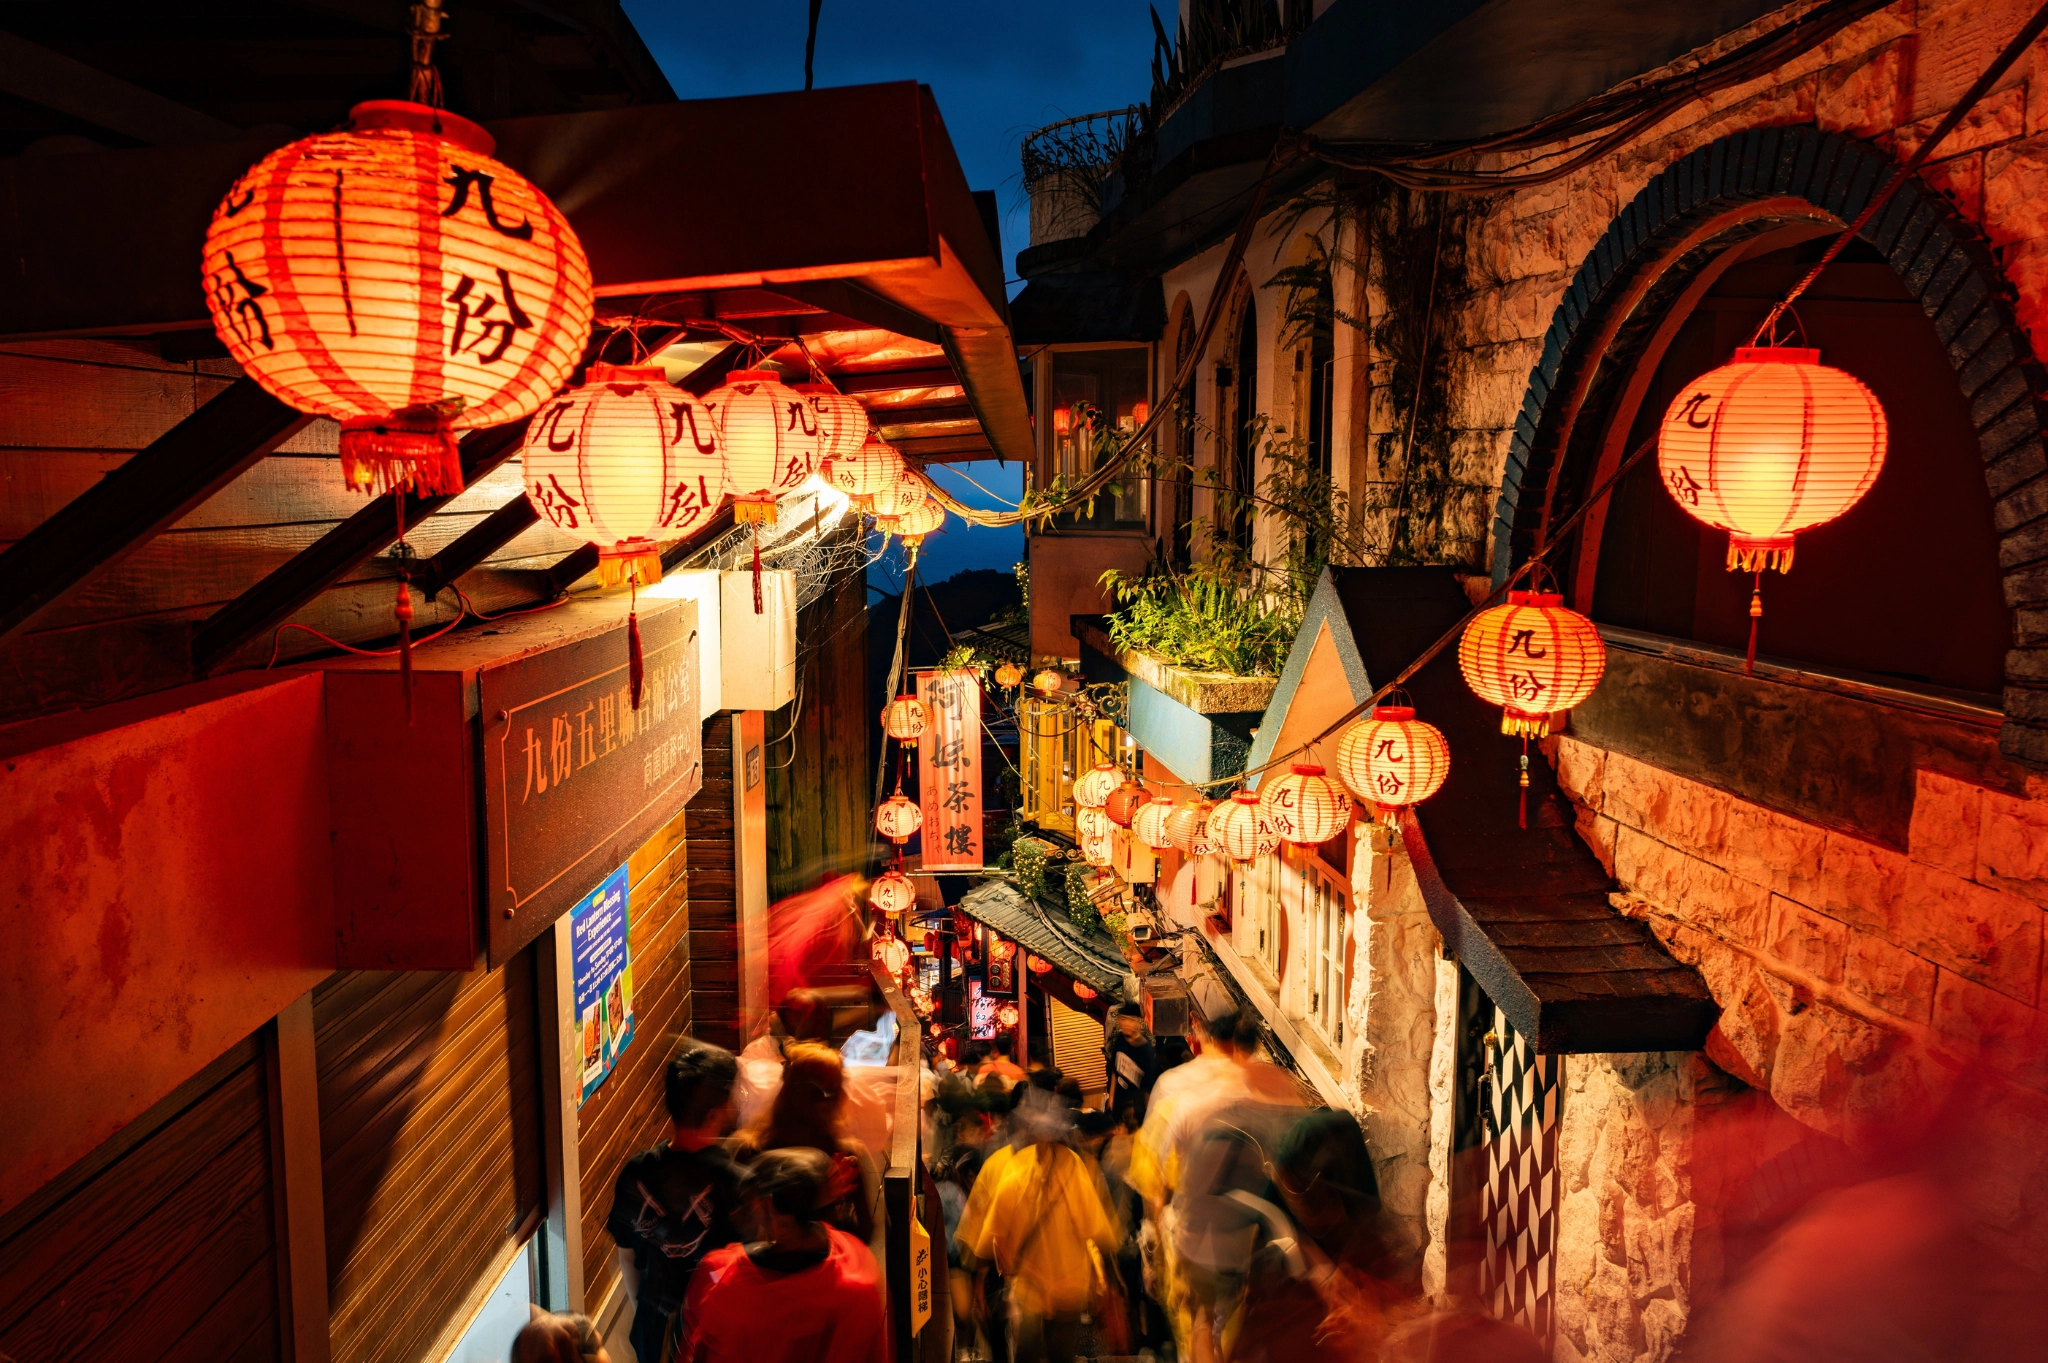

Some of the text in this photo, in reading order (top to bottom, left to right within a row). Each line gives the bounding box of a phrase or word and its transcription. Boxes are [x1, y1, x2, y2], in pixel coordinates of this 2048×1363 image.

[441, 165, 534, 365] 九份
[532, 400, 581, 529] 九份
[661, 401, 717, 529] 九份
[779, 401, 817, 488] 九份
[1670, 392, 1711, 507] 九份
[900, 472, 917, 507] 九份
[1507, 629, 1547, 702] 九份
[521, 655, 690, 806] 九份五里聯合辦公室
[910, 707, 924, 734] 九份
[925, 679, 978, 857] 阿妹茶樓
[1374, 739, 1405, 795] 九份
[883, 810, 895, 835] 九份
[926, 785, 943, 853] あめおちゃ
[1194, 821, 1209, 854] 九份
[1258, 820, 1274, 855] 九份
[1273, 788, 1296, 835] 九份
[576, 918, 586, 938] Red
[586, 906, 604, 930] Lantern
[603, 890, 620, 913] Blessing
[882, 887, 893, 909] 九份
[588, 912, 612, 941] Experience
